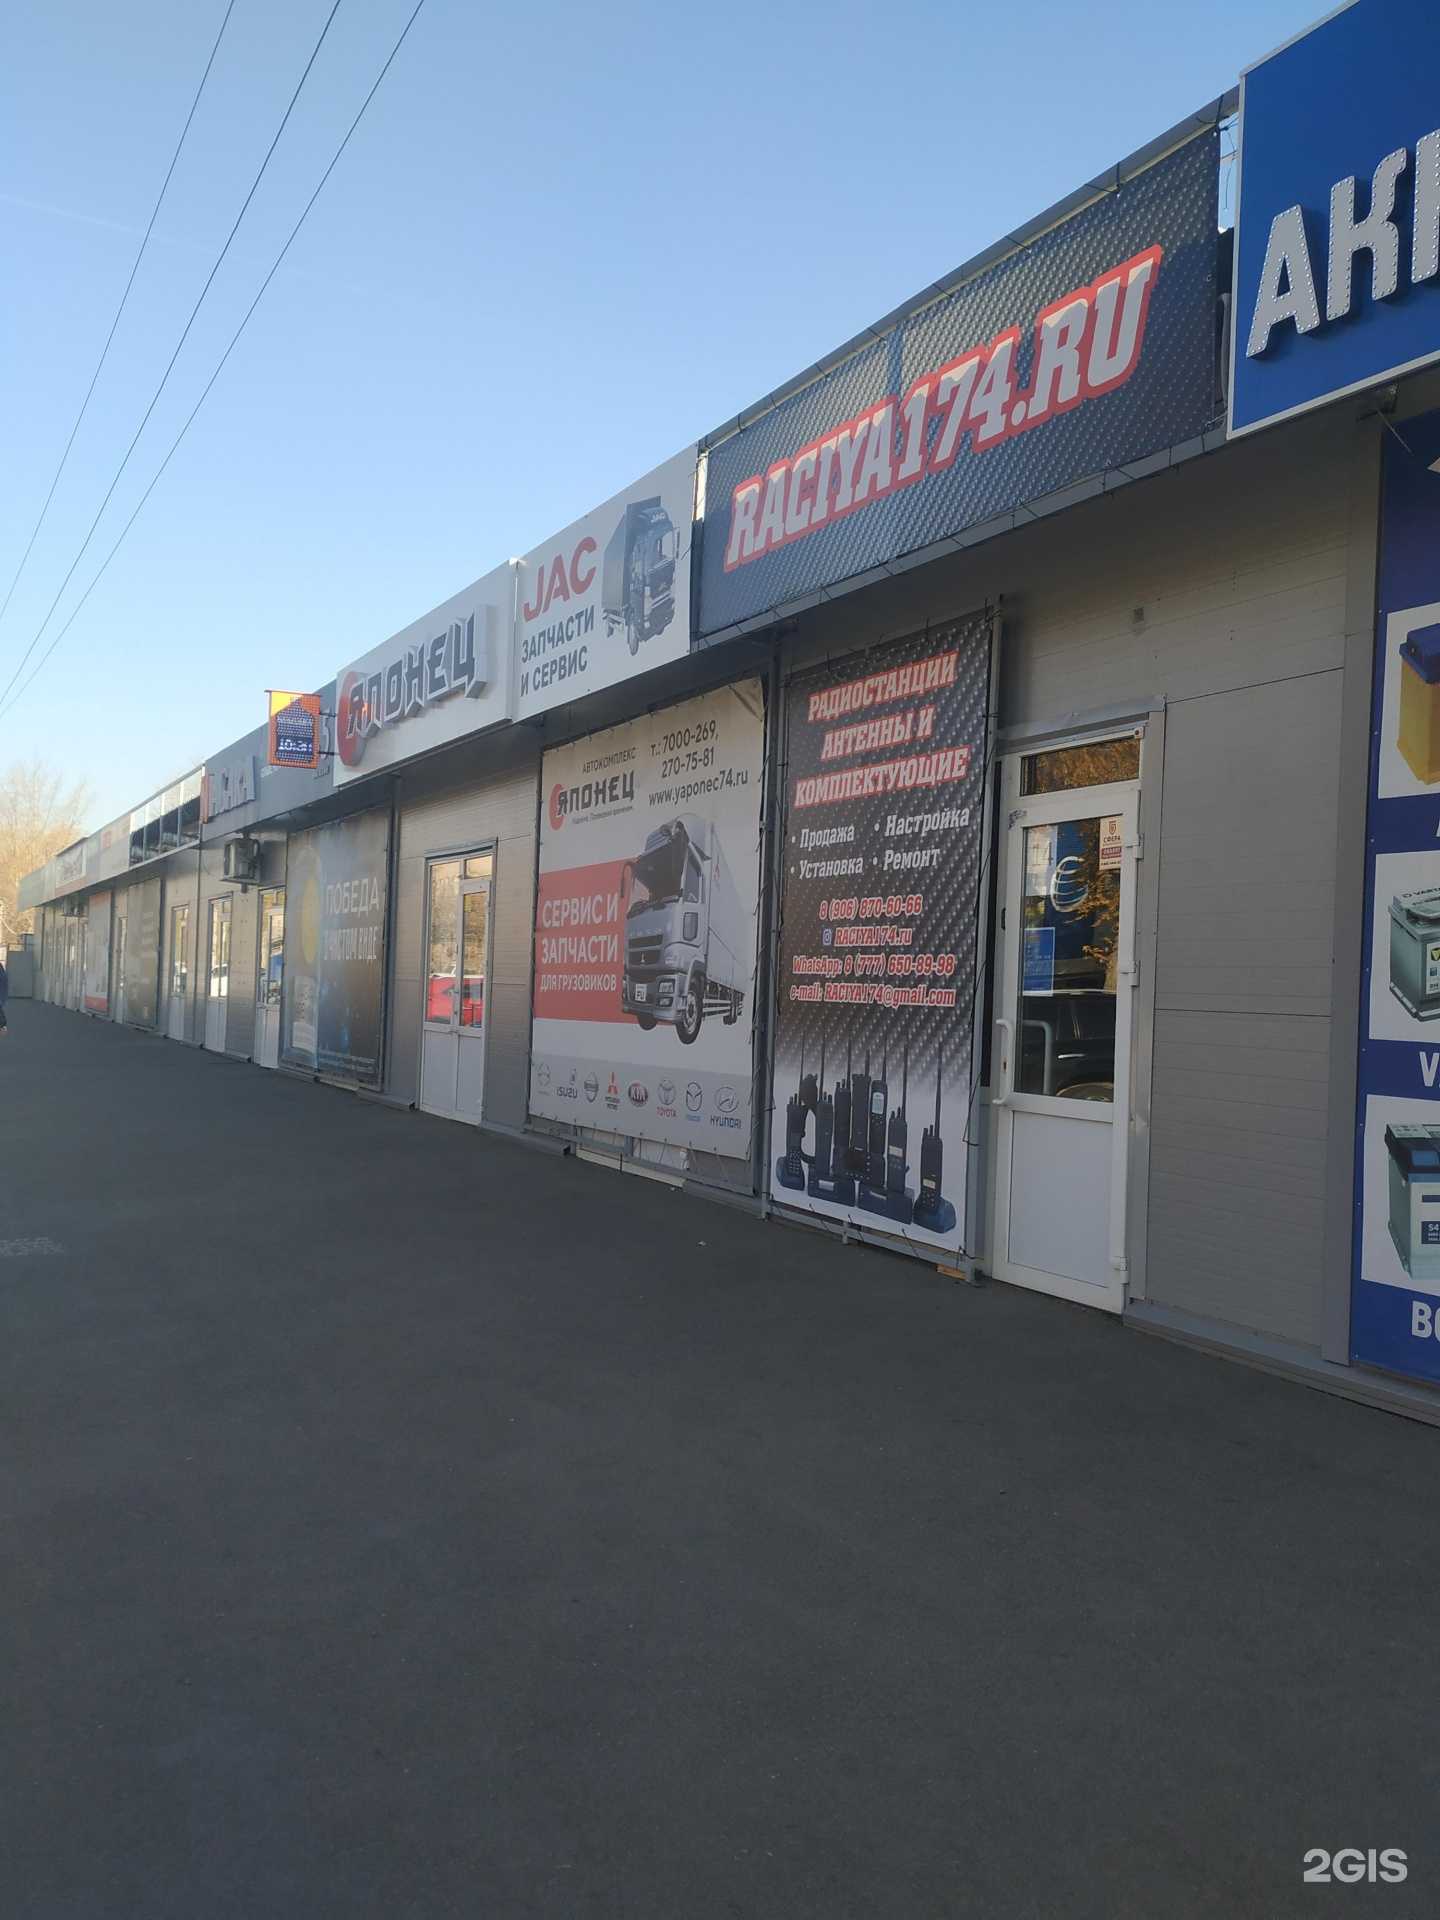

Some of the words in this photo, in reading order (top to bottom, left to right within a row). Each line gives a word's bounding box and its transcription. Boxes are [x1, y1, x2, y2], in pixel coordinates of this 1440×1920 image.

[724, 246, 1162, 572] RACIYA174.RU
[522, 536, 598, 623] JAC
[520, 604, 595, 664] ЗАПЧАСТИ
[343, 607, 478, 739] ЯПОНЕЦ
[520, 672, 529, 698] И
[533, 646, 588, 692] СЕРВИС
[808, 650, 959, 722] РАДИОСТАНЦИИ
[820, 712, 914, 761] АНТЕННЫ
[916, 705, 937, 739] И
[582, 747, 636, 773] АВТОКОМПЛЕКС
[661, 748, 715, 779] 270-75-81
[793, 745, 972, 808] КОМПЛЕКТУЮЩИЕ
[557, 770, 635, 816] ЯПОНЕЦ
[648, 769, 748, 807] www.yaponec74.ru
[800, 825, 855, 851] Продажа
[885, 807, 970, 836] Настройка
[799, 857, 863, 879] Установка
[883, 848, 940, 871] Ремонт
[326, 877, 379, 917] ПОБЕДА
[542, 895, 602, 928] СЕРВИС
[606, 893, 618, 922] И
[541, 934, 618, 965] ЗАПЧАСТИ
[1419, 1051, 1440, 1088] V
